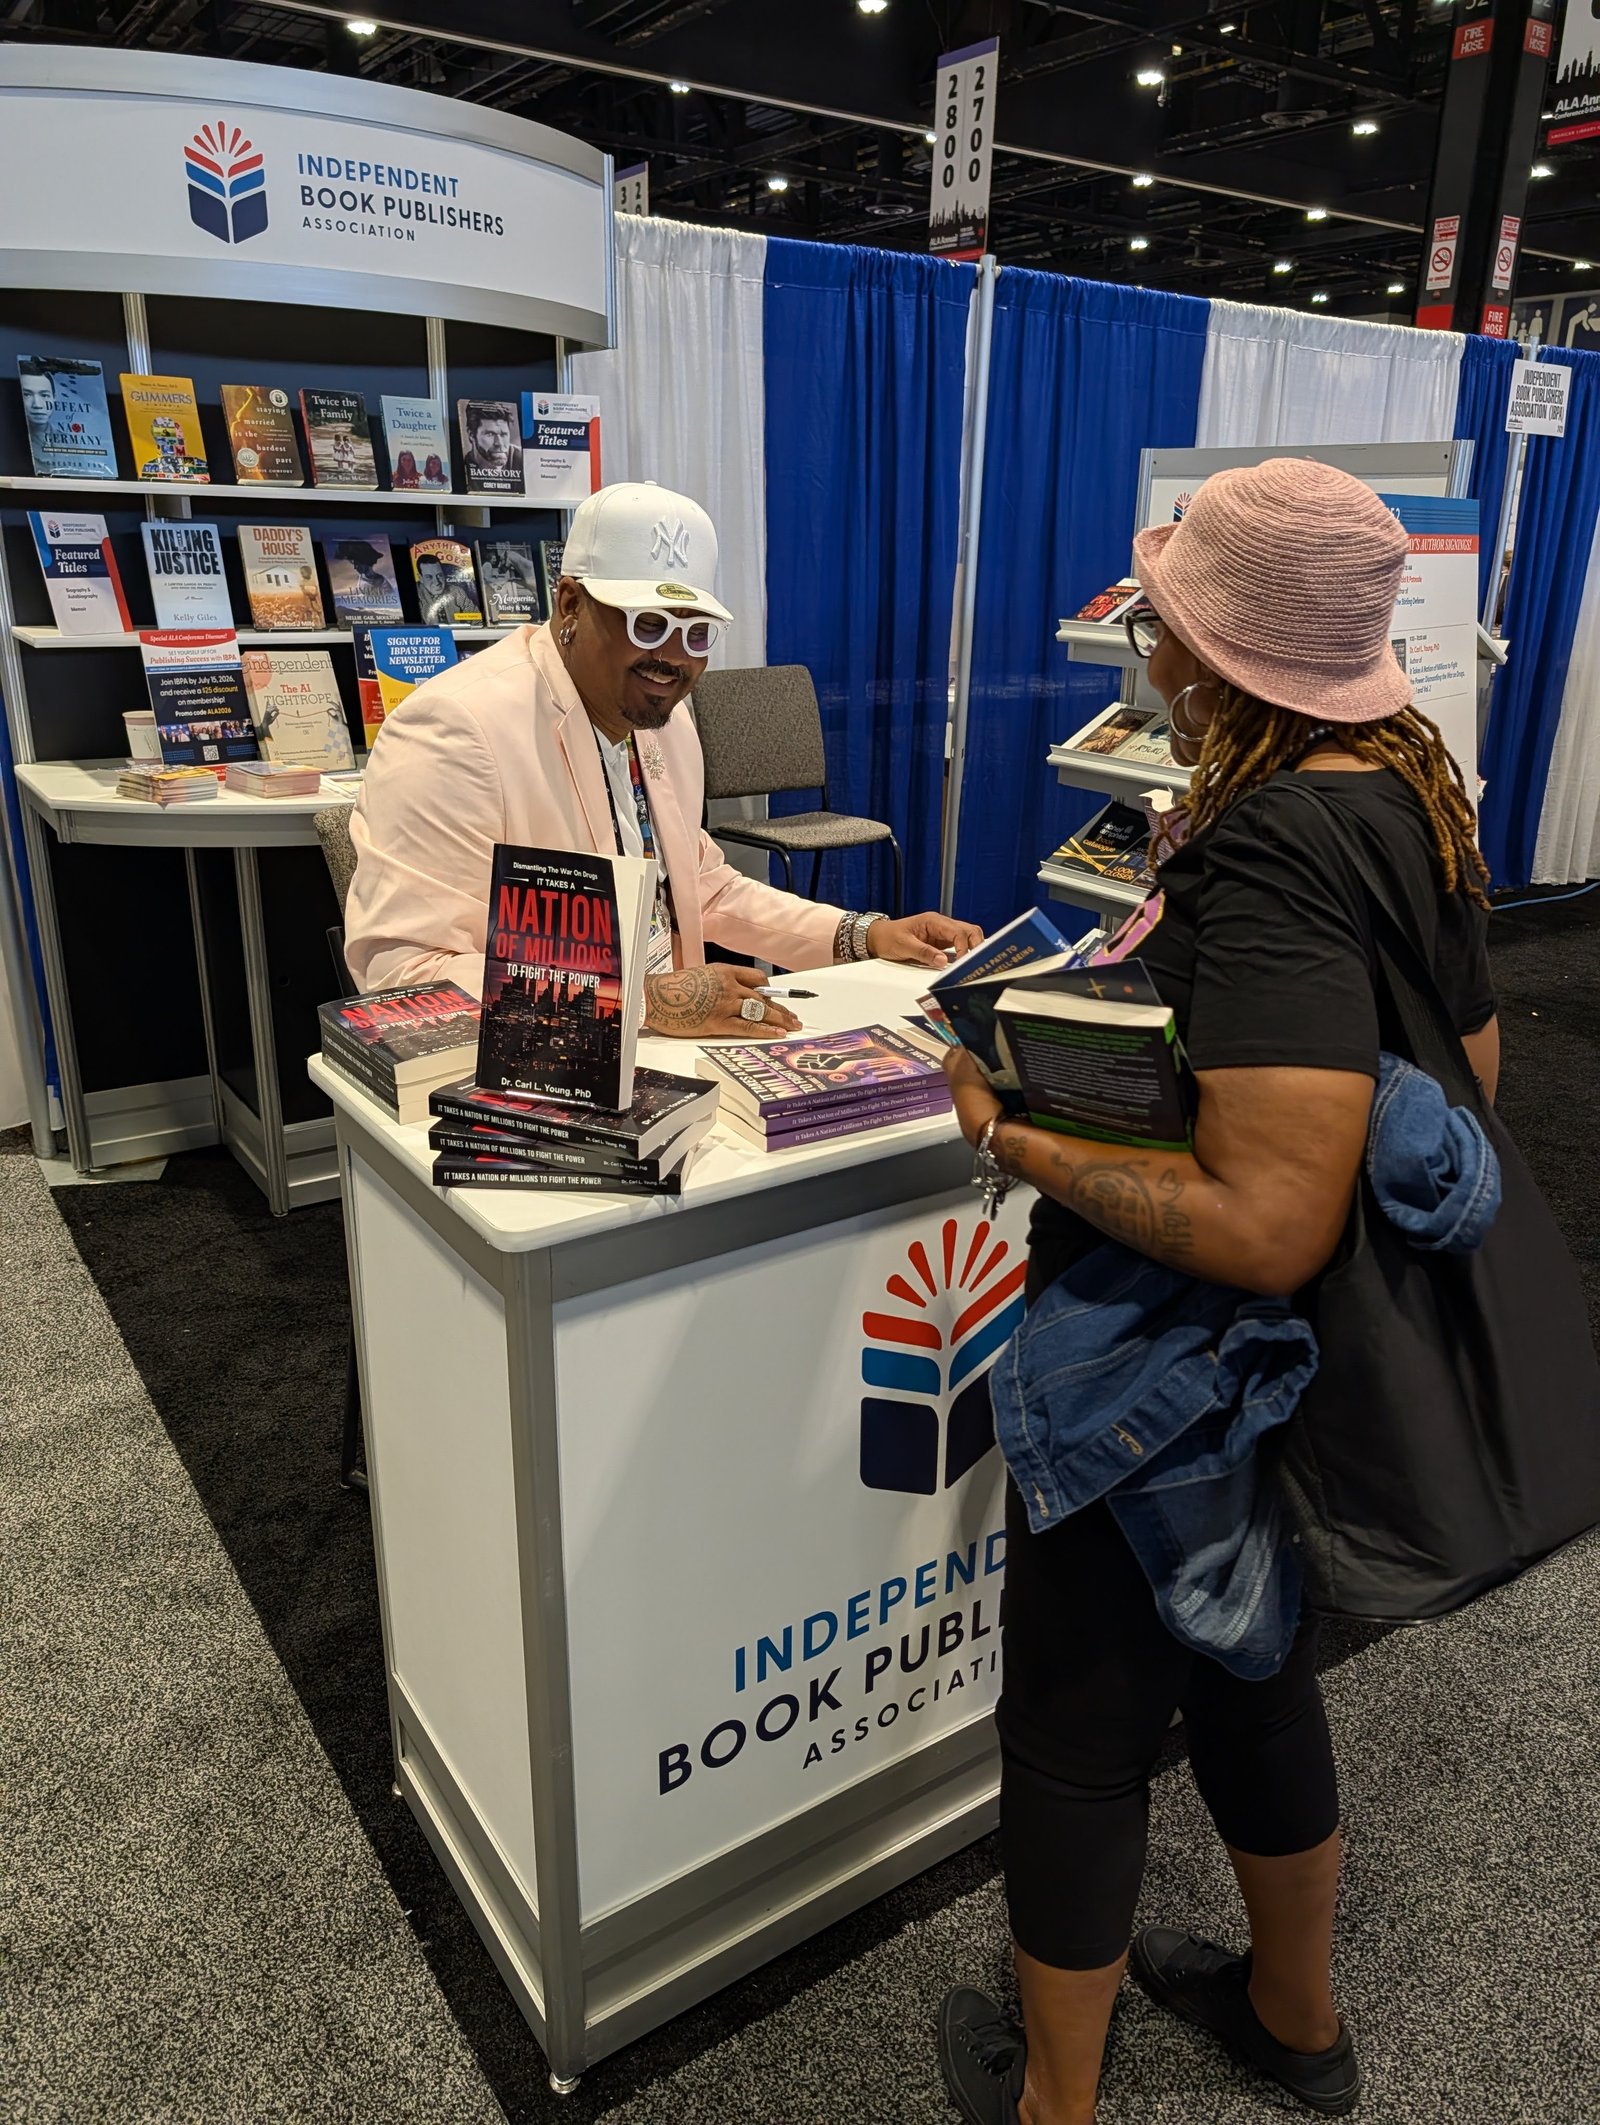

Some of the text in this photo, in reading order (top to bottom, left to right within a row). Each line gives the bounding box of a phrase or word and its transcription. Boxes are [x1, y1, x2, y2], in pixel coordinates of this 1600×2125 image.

[1464, 26, 1485, 41] FIRE
[1532, 25, 1547, 39] FIRE
[1461, 39, 1484, 54] HOSE
[1529, 38, 1546, 52] HOSE
[1555, 97, 1579, 112] ALA
[969, 66, 984, 182] 2700
[943, 75, 958, 188] 2800
[299, 153, 458, 198] INDEPENDENT
[301, 185, 504, 236] BOOK PUBLISHERS
[303, 217, 415, 241] ASSOCIATION
[1488, 310, 1503, 322] FIRE
[1484, 323, 1503, 336] HOSE
[1523, 369, 1561, 388] INDEPENDENT
[131, 391, 192, 404] GLIMMERS
[312, 395, 357, 407] Twice the
[1516, 385, 1564, 405] BOOK PUBLISHERS
[46, 401, 91, 413] DEFEAT
[256, 407, 286, 415] staying
[396, 408, 424, 417] Twice
[1510, 401, 1547, 419] ASSOCIATION
[66, 413, 74, 422] of
[320, 408, 352, 421] Family
[58, 423, 85, 433] NAI
[392, 420, 436, 432] Daughter
[538, 424, 585, 436] Featured
[45, 433, 102, 446] GERMANY
[538, 435, 568, 446] Titles
[470, 468, 521, 478] BACKSTORY
[150, 529, 214, 552] KILLING
[253, 528, 303, 541] DADDY'S
[262, 543, 300, 555] HOUSE
[651, 516, 690, 569] NY
[1421, 538, 1444, 550] AUTHOR
[55, 549, 100, 560] Featured
[414, 541, 468, 558] ANYTHIG
[155, 552, 221, 575] JUSTICE
[435, 551, 466, 566] GOES
[58, 561, 88, 572] Titles
[340, 595, 398, 605] MEMORIES
[174, 614, 194, 623] Kelly
[387, 637, 440, 646] SIGN UP FOR
[391, 646, 440, 655] IBPA'S FREE
[247, 653, 333, 674] independent
[389, 656, 446, 665] NEWSLETTER
[404, 665, 435, 674] TODAY!
[189, 678, 196, 686] by
[280, 684, 311, 693] The AI
[187, 696, 225, 705] membership!
[264, 693, 331, 705] TIGHTROPE
[1083, 839, 1116, 852] catalogue
[514, 862, 546, 873] Dismantling
[583, 871, 598, 880] Drugs
[1103, 869, 1134, 881] CLOSER
[1113, 866, 1136, 875] LOOK
[545, 879, 568, 889] TAKES
[498, 885, 612, 945] NATION
[496, 933, 519, 959] OF
[524, 936, 612, 973] MILLIONS
[989, 953, 1007, 966] PATH
[1007, 945, 1018, 955] TO
[507, 963, 600, 988] TO FIGHT THE POWER
[340, 990, 465, 1023] NATION
[766, 1058, 787, 1071] THE
[720, 1047, 804, 1099] MILLIONS
[779, 1070, 807, 1083] FIGHT
[501, 1077, 512, 1086] Dr.
[515, 1080, 531, 1089] Carl
[575, 1089, 591, 1098] PhD
[740, 1076, 770, 1094] TAKES
[800, 1083, 816, 1094] TO
[444, 1106, 459, 1115] TAKES
[465, 1110, 482, 1120] NATION
[484, 1114, 490, 1122] OF
[491, 1116, 515, 1128] MILLIONS
[516, 1120, 523, 1128] TO
[524, 1123, 538, 1132] FIGHT
[540, 1126, 549, 1134] THE
[551, 1128, 569, 1138] POWER
[801, 1132, 814, 1140] Takes
[820, 1127, 836, 1136] Nation
[843, 1121, 862, 1131] Millions
[870, 1117, 882, 1126] Fight
[893, 1112, 907, 1120] Power
[908, 1108, 925, 1117] Volume
[452, 1172, 470, 1180] TAKES
[476, 1173, 499, 1182] NATION
[500, 1174, 508, 1182] OF
[510, 1174, 538, 1183] MILLIONS
[568, 1176, 579, 1184] THE
[735, 1529, 1008, 1693] INDEPEND
[802, 1650, 997, 1770] ASSOCIATI
[659, 1667, 844, 1796] BOOK
